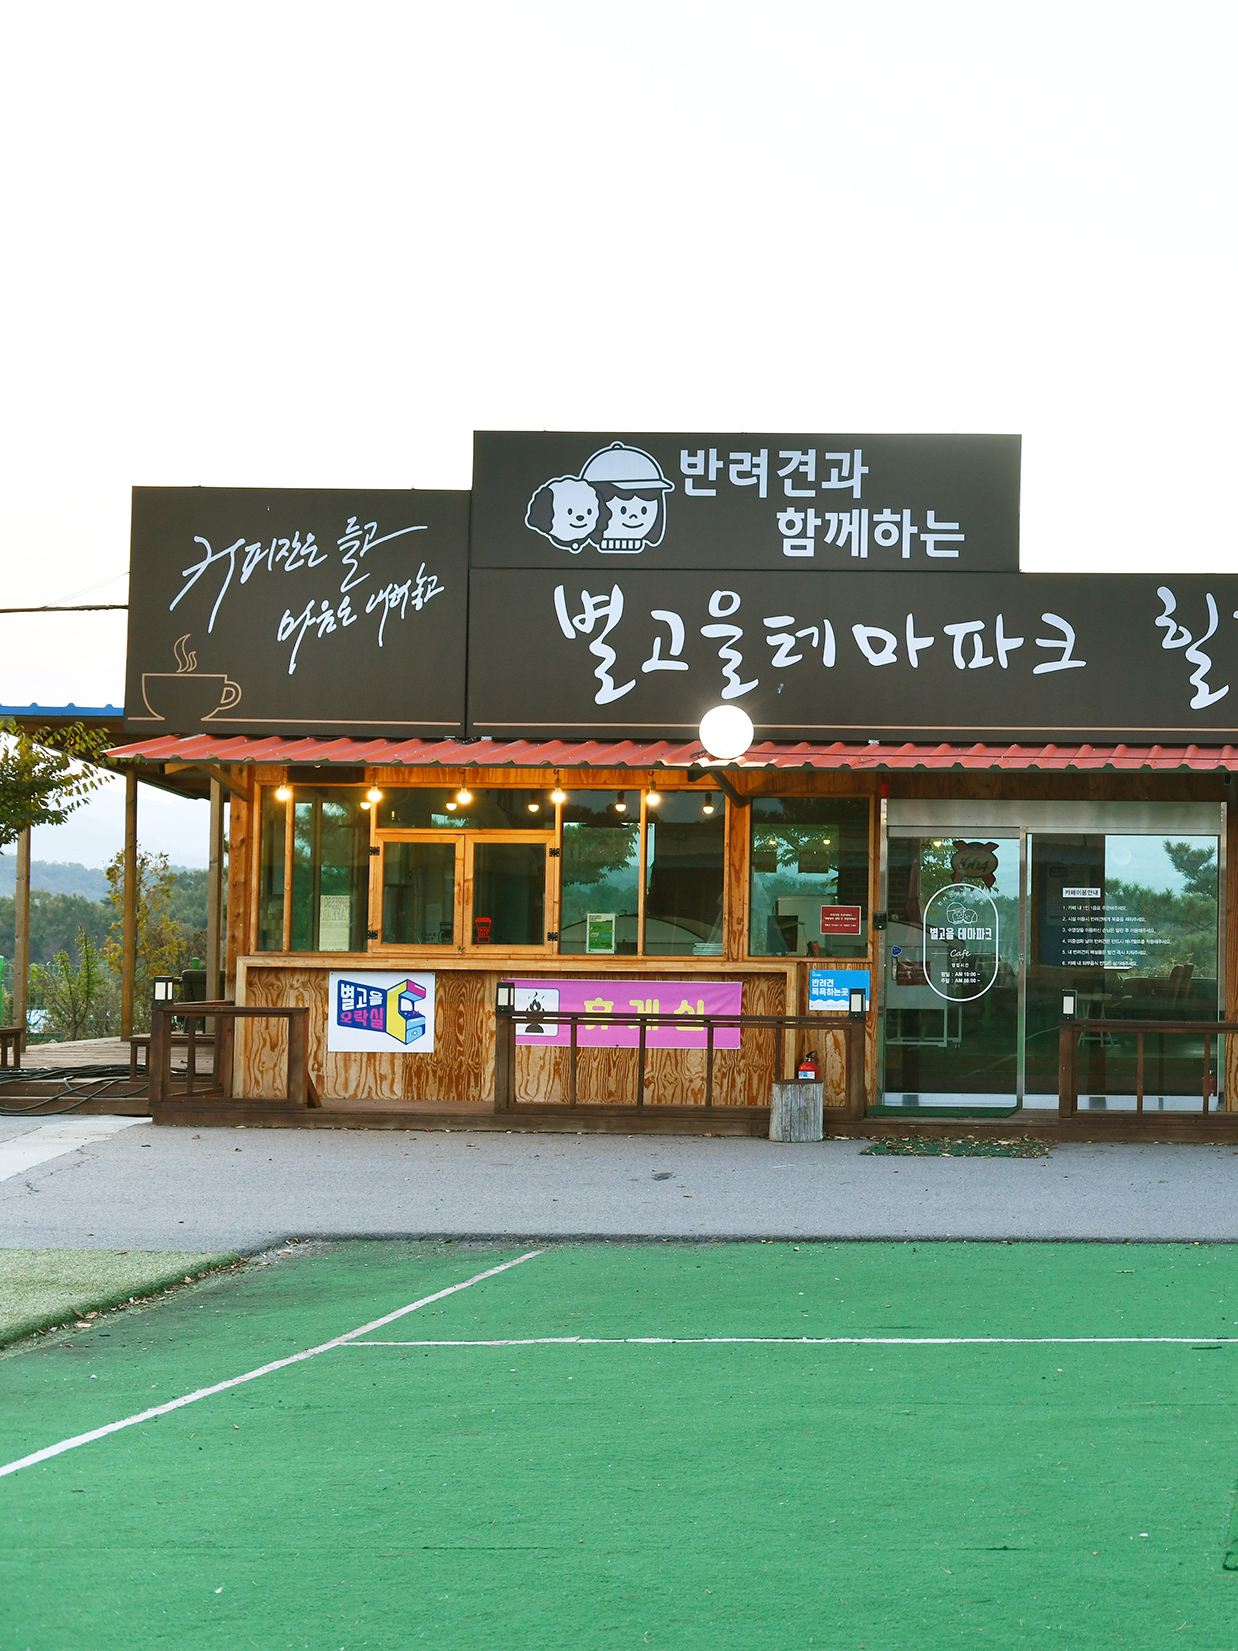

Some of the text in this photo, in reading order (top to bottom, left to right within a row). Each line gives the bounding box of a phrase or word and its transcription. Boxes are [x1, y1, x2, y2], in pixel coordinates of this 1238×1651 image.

[681, 449, 869, 499] 반려견과
[776, 507, 965, 559] 함께하는
[169, 516, 428, 634] 커피잔은 들고
[277, 562, 445, 675] 마음은 내려놓고
[553, 584, 1087, 705] 별고을테마파크
[930, 927, 992, 940] 별고을 테마파크
[949, 948, 972, 959] Cafe
[341, 983, 383, 1011] 별고을
[811, 978, 834, 987] 반려견
[341, 1007, 384, 1030] 오락실
